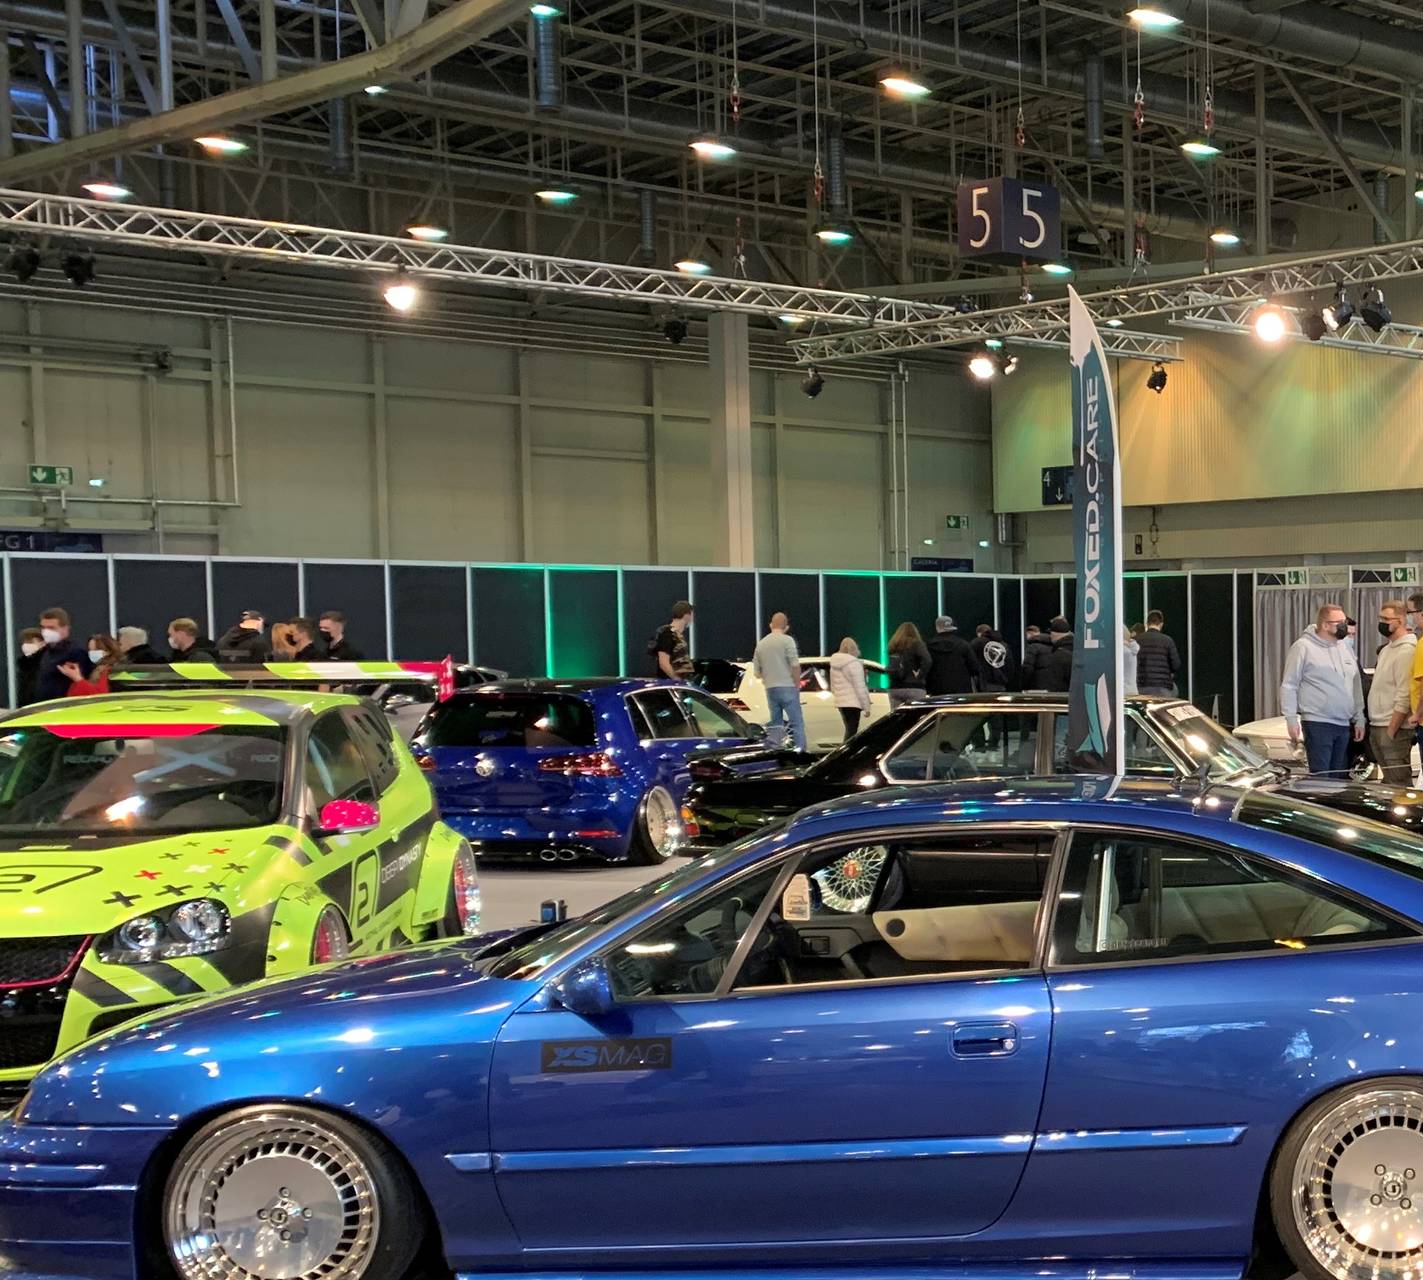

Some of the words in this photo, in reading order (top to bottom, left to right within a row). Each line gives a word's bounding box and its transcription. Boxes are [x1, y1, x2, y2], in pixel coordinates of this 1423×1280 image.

[969, 186, 991, 249] 5
[1018, 187, 1046, 249] 5
[1043, 470, 1051, 488] 4
[1084, 375, 1101, 650] FOXED.CARE
[357, 881, 371, 928] 2
